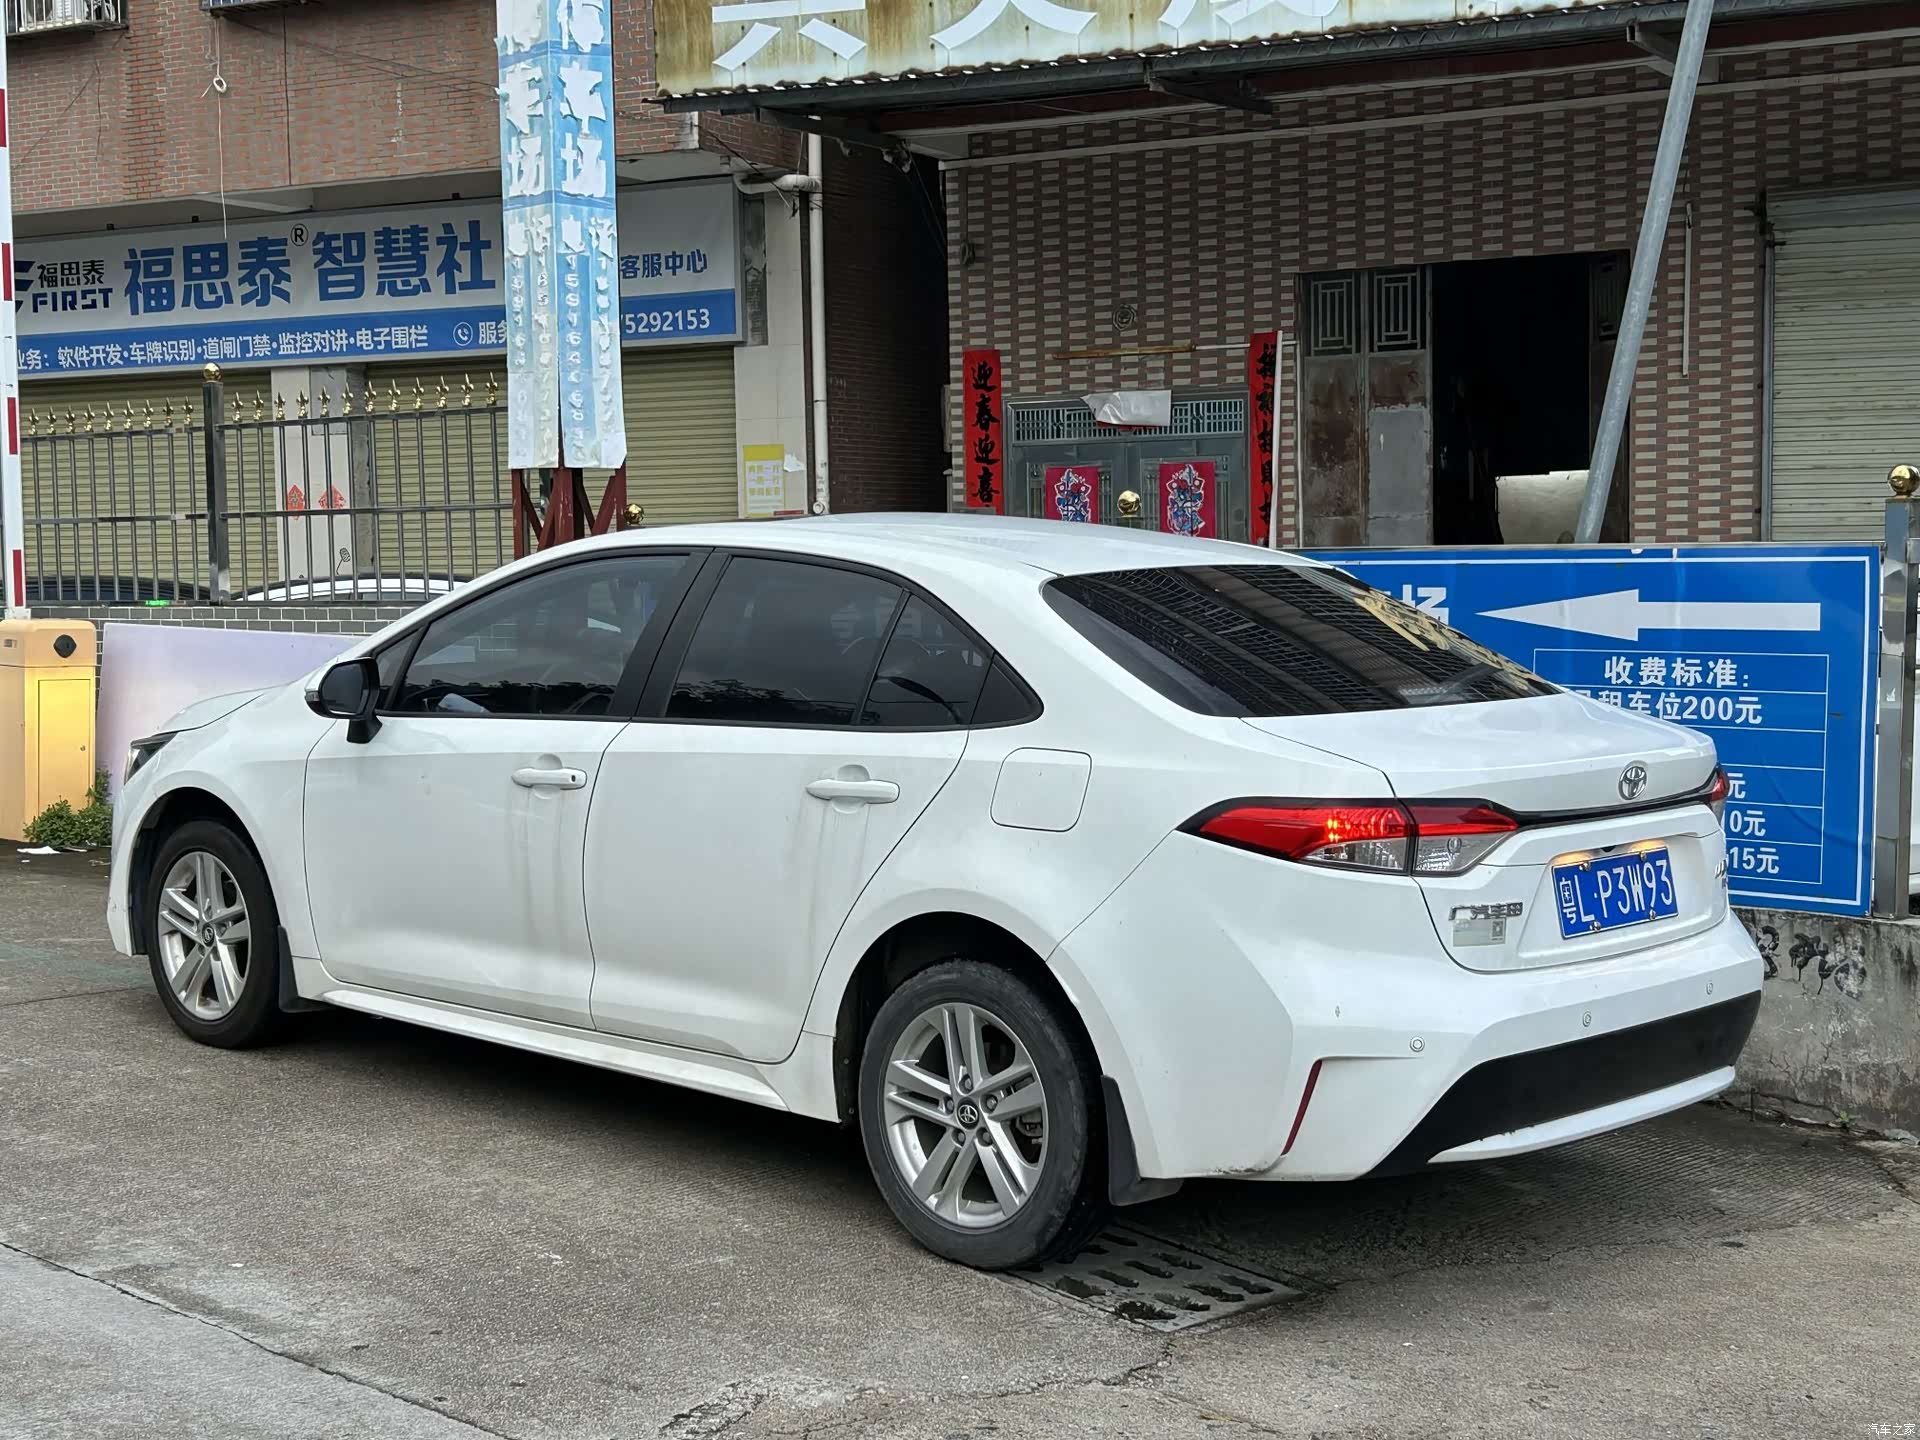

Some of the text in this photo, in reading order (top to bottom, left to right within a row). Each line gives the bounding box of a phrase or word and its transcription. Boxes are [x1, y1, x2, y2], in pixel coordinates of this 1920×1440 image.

[37, 259, 105, 289] 福思泰
[620, 248, 708, 279] 客服中心
[32, 287, 113, 313] FIRST
[621, 308, 710, 334] 5292153
